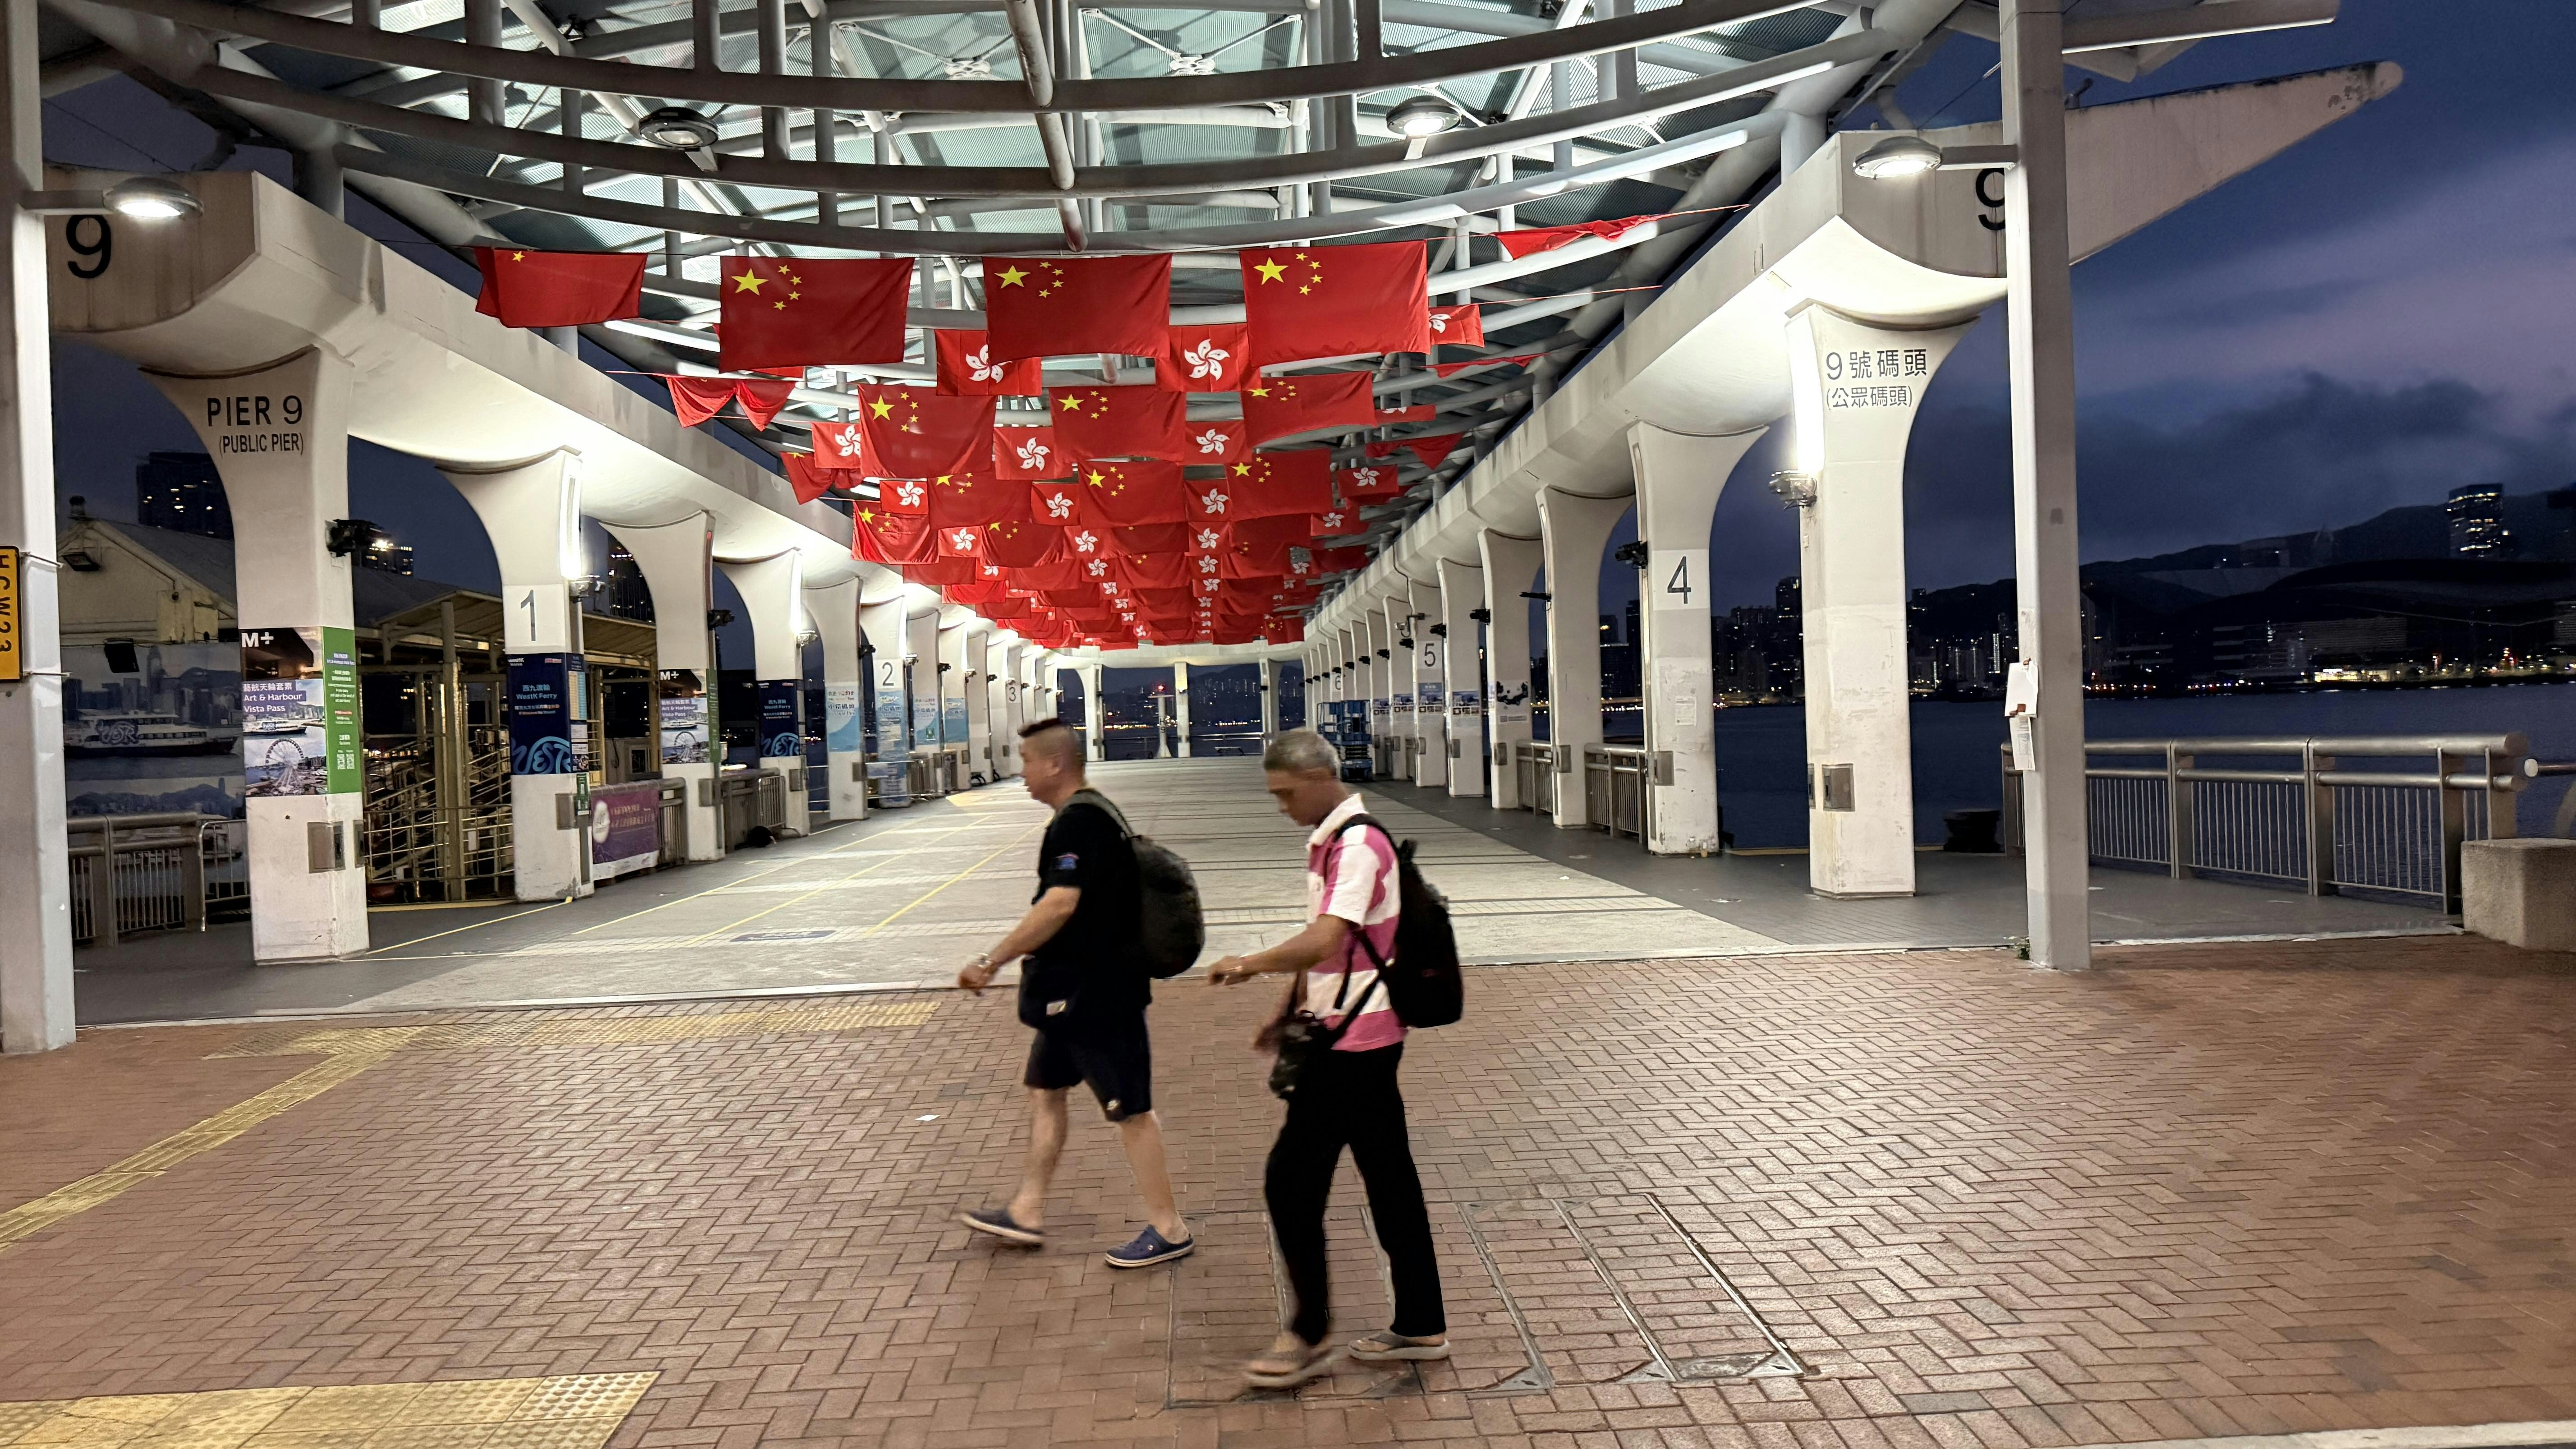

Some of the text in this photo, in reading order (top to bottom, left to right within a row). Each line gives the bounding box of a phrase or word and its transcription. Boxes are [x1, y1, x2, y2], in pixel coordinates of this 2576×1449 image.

[1974, 168, 2005, 230] 9
[66, 214, 111, 279] 9
[207, 395, 302, 426] PIER 9
[220, 432, 304, 458] (PUBLIC PIER)
[1667, 556, 1691, 604] 4
[520, 589, 536, 641] 1
[1425, 643, 1436, 667] 5
[882, 662, 894, 686] 2
[1335, 676, 1341, 690] 6
[1009, 686, 1016, 702] 3
